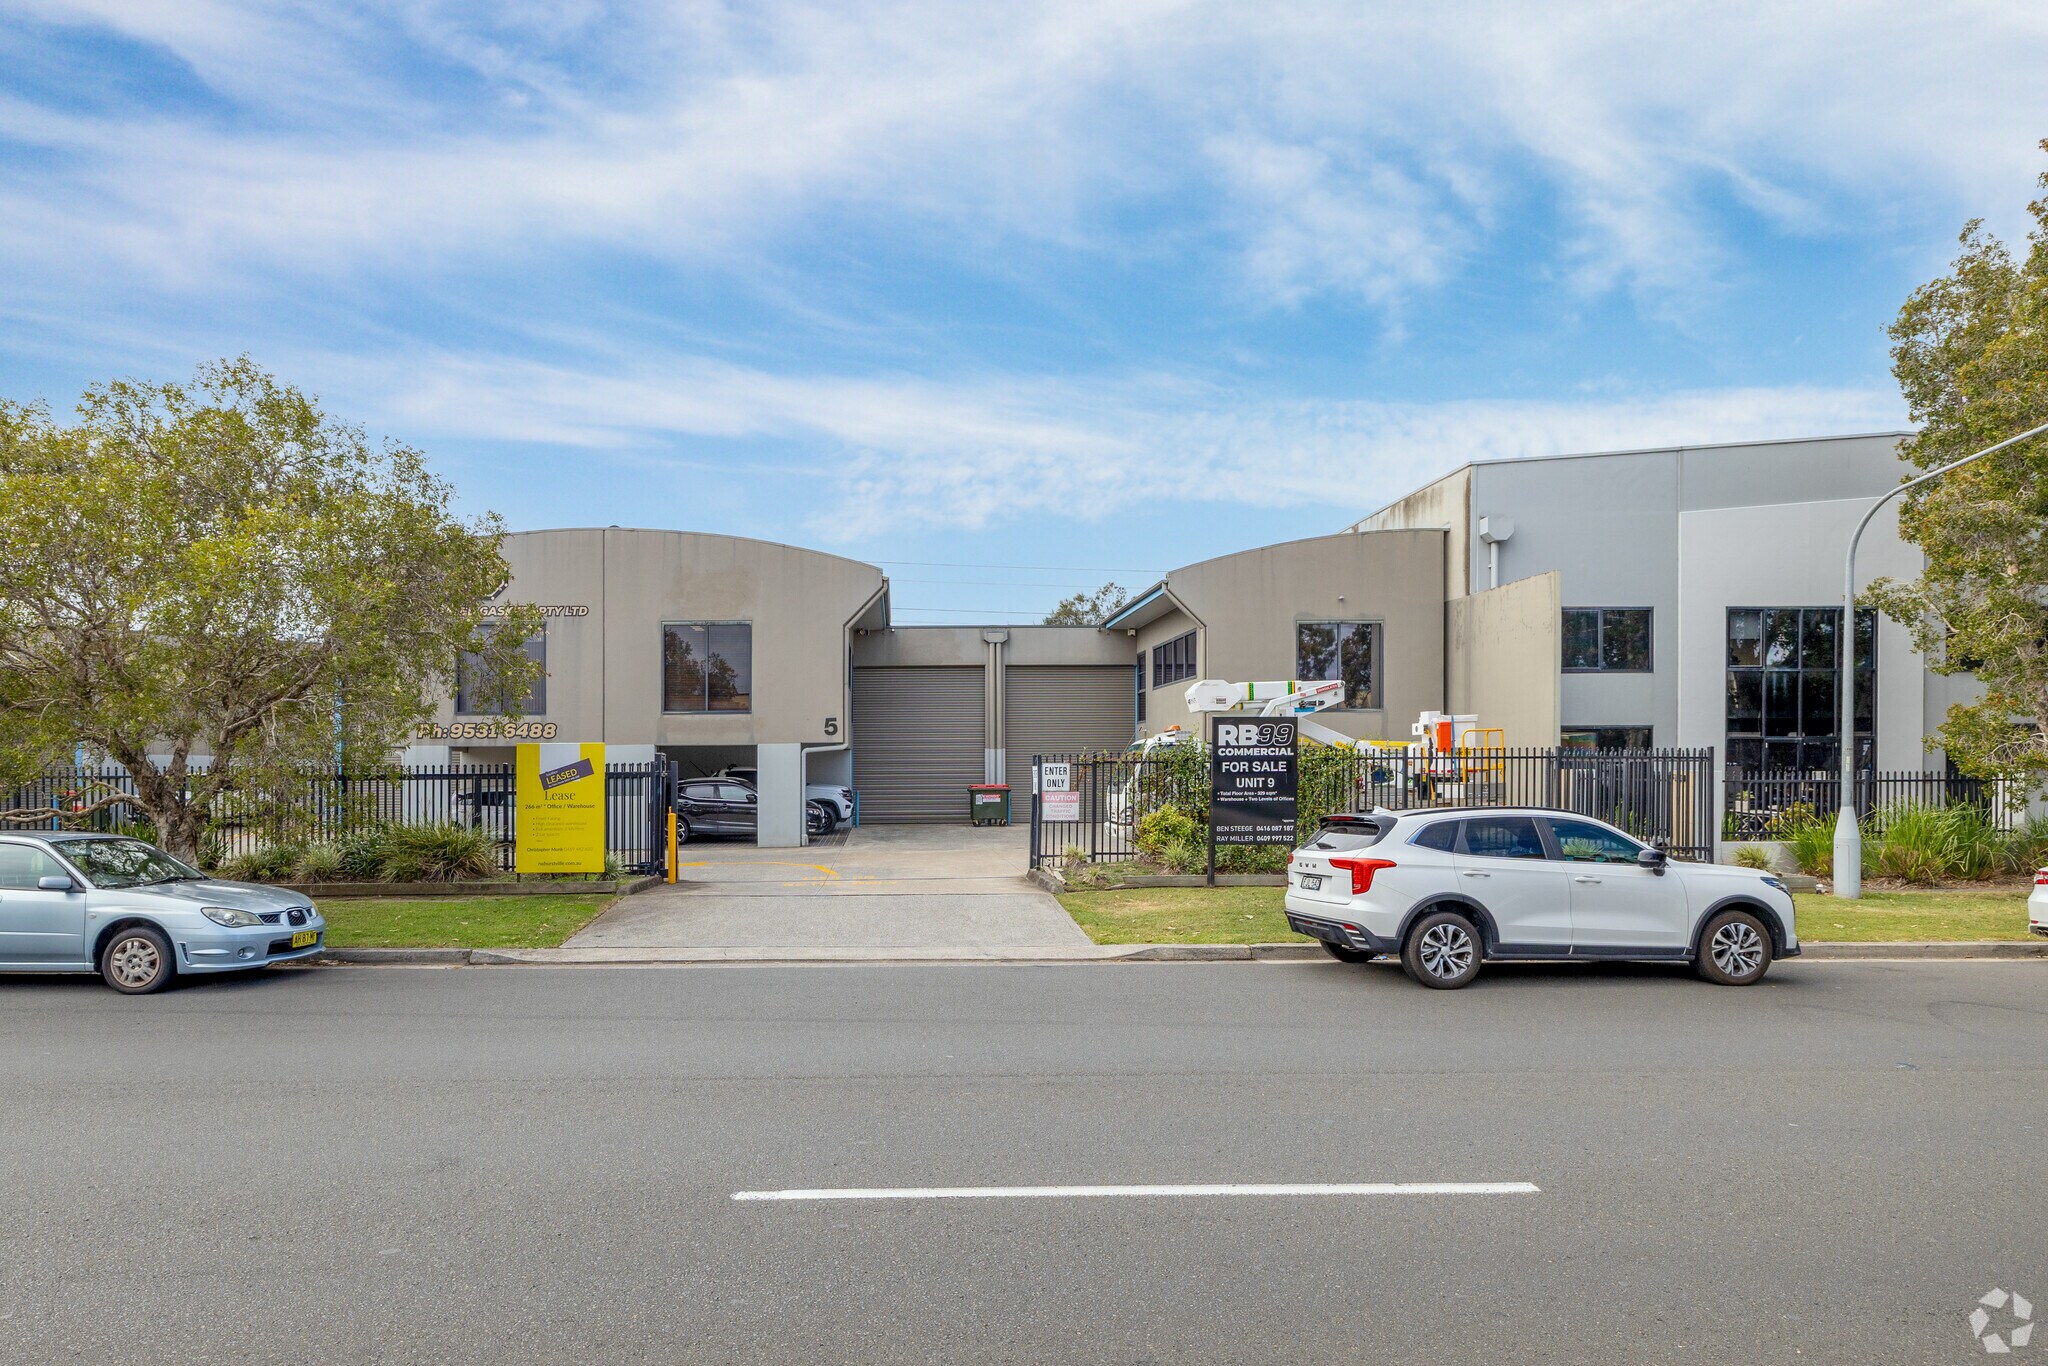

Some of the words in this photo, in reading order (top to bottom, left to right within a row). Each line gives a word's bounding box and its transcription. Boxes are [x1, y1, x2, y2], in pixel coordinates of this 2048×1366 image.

[538, 605, 564, 616] PTY
[564, 605, 589, 616] LTD
[449, 722, 498, 739] 9531
[503, 722, 557, 739] 6488
[824, 717, 838, 736] 5
[1218, 724, 1294, 746] RB99
[1218, 747, 1294, 756] COMMERCIAL
[1045, 767, 1068, 775] ENTER
[1222, 762, 1249, 772] FOR
[1252, 761, 1287, 772] SALE
[546, 768, 578, 784] LEASED
[1046, 779, 1065, 788] ONLY
[1236, 777, 1265, 787] UNIT
[1267, 778, 1275, 788] 9
[544, 791, 576, 800] Lease
